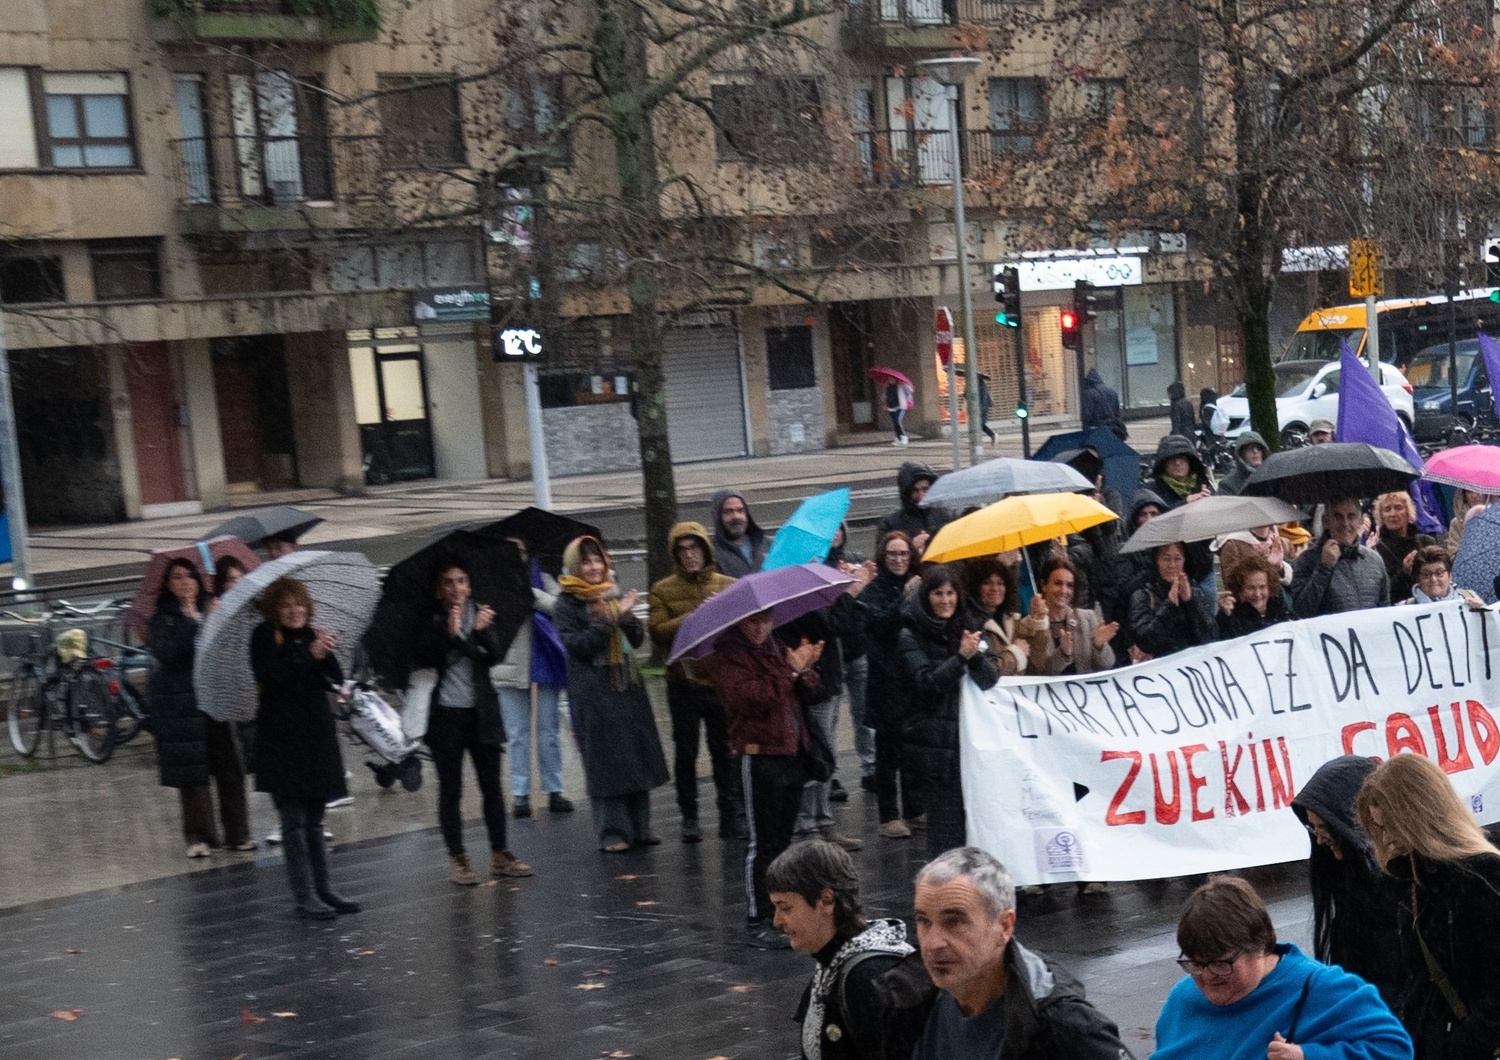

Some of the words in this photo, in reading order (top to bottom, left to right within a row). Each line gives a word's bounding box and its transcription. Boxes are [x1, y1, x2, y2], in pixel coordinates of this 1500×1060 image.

[989, 655, 1254, 739] LKARTASUNA
[1251, 638, 1313, 714] EZ
[1320, 629, 1381, 703] DA
[1101, 730, 1295, 828] ZUEKIN
